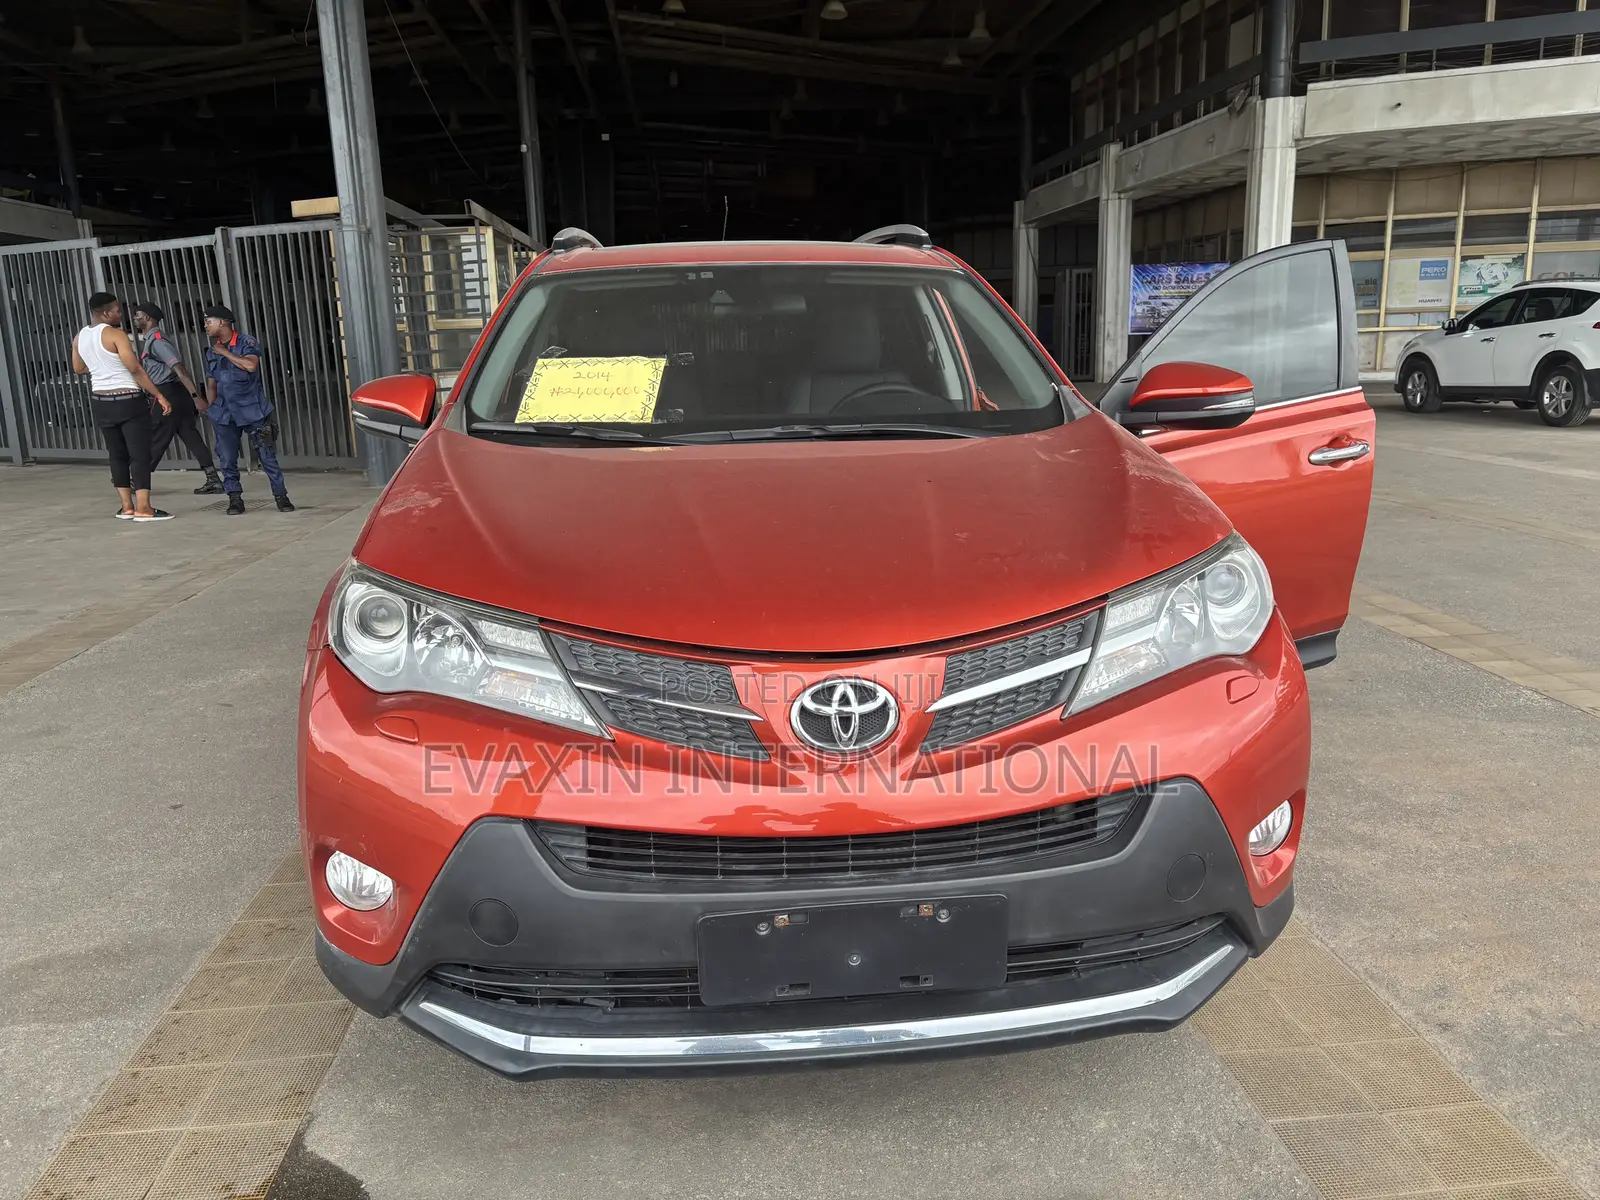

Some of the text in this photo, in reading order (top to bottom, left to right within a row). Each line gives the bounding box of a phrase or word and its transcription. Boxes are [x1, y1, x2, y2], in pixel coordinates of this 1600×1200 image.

[1142, 272, 1211, 285] CARS SALES
[573, 371, 613, 382] 2014
